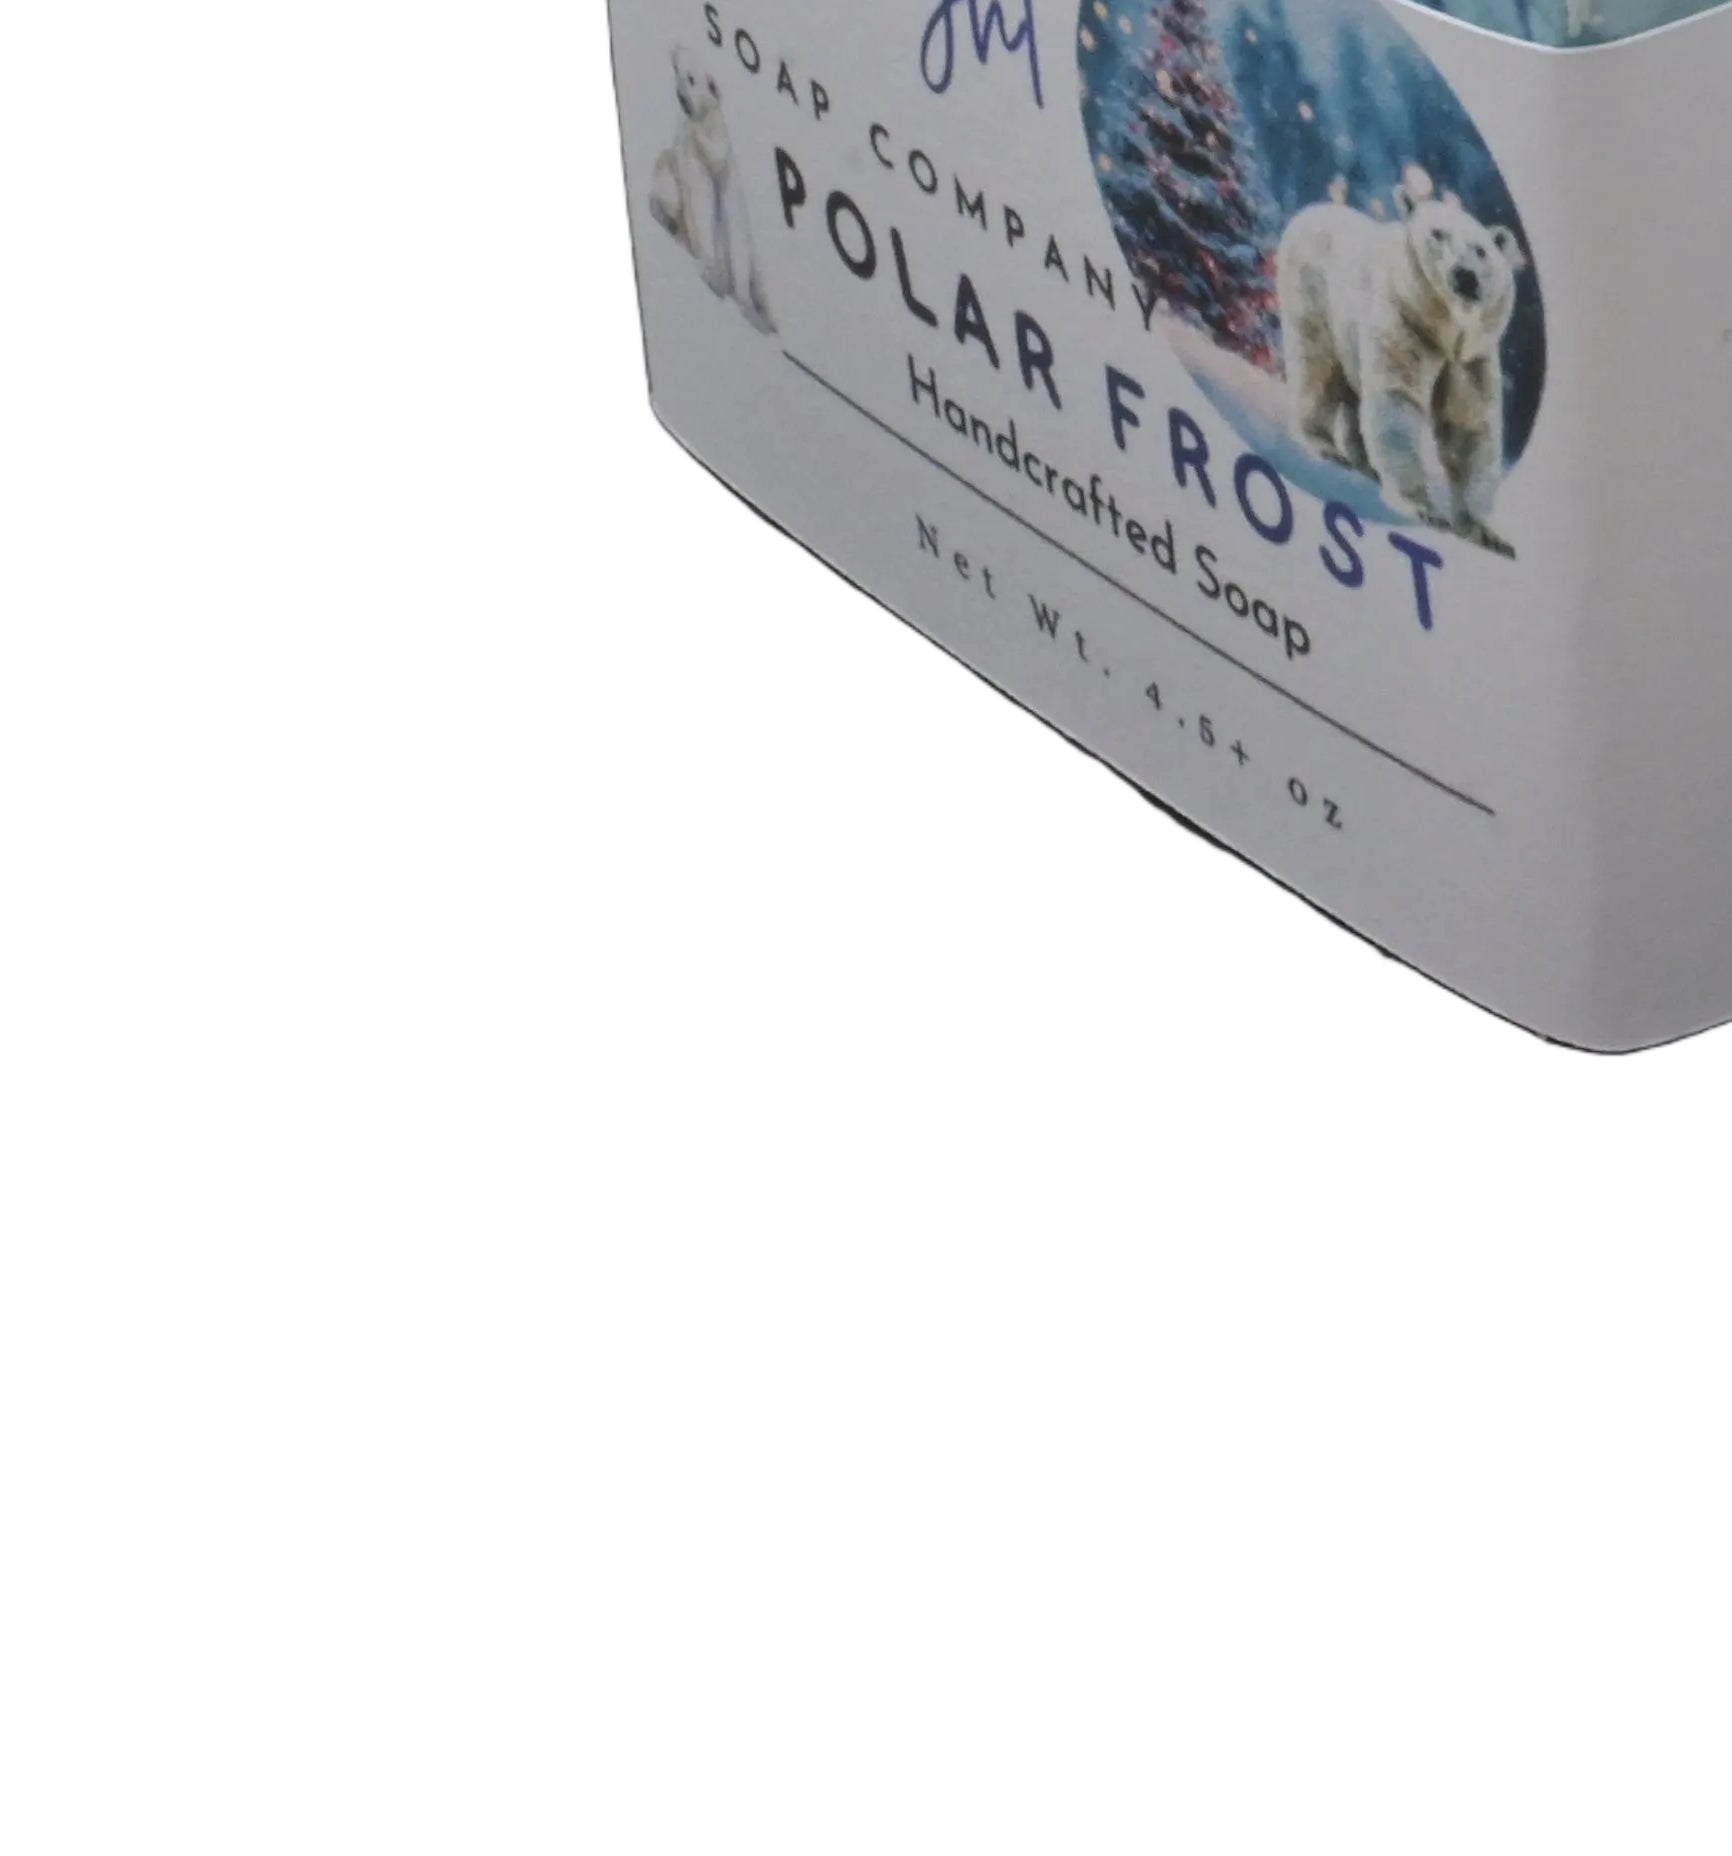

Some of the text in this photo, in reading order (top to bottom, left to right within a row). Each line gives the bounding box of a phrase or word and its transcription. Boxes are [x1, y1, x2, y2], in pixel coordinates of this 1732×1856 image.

[703, 2, 1160, 332] SOAP COMPANY
[774, 146, 1445, 633] POLAR FROST
[905, 352, 1313, 662] Handcrafted Soap
[916, 514, 1344, 832] Net Wt. 4.5+ oz
